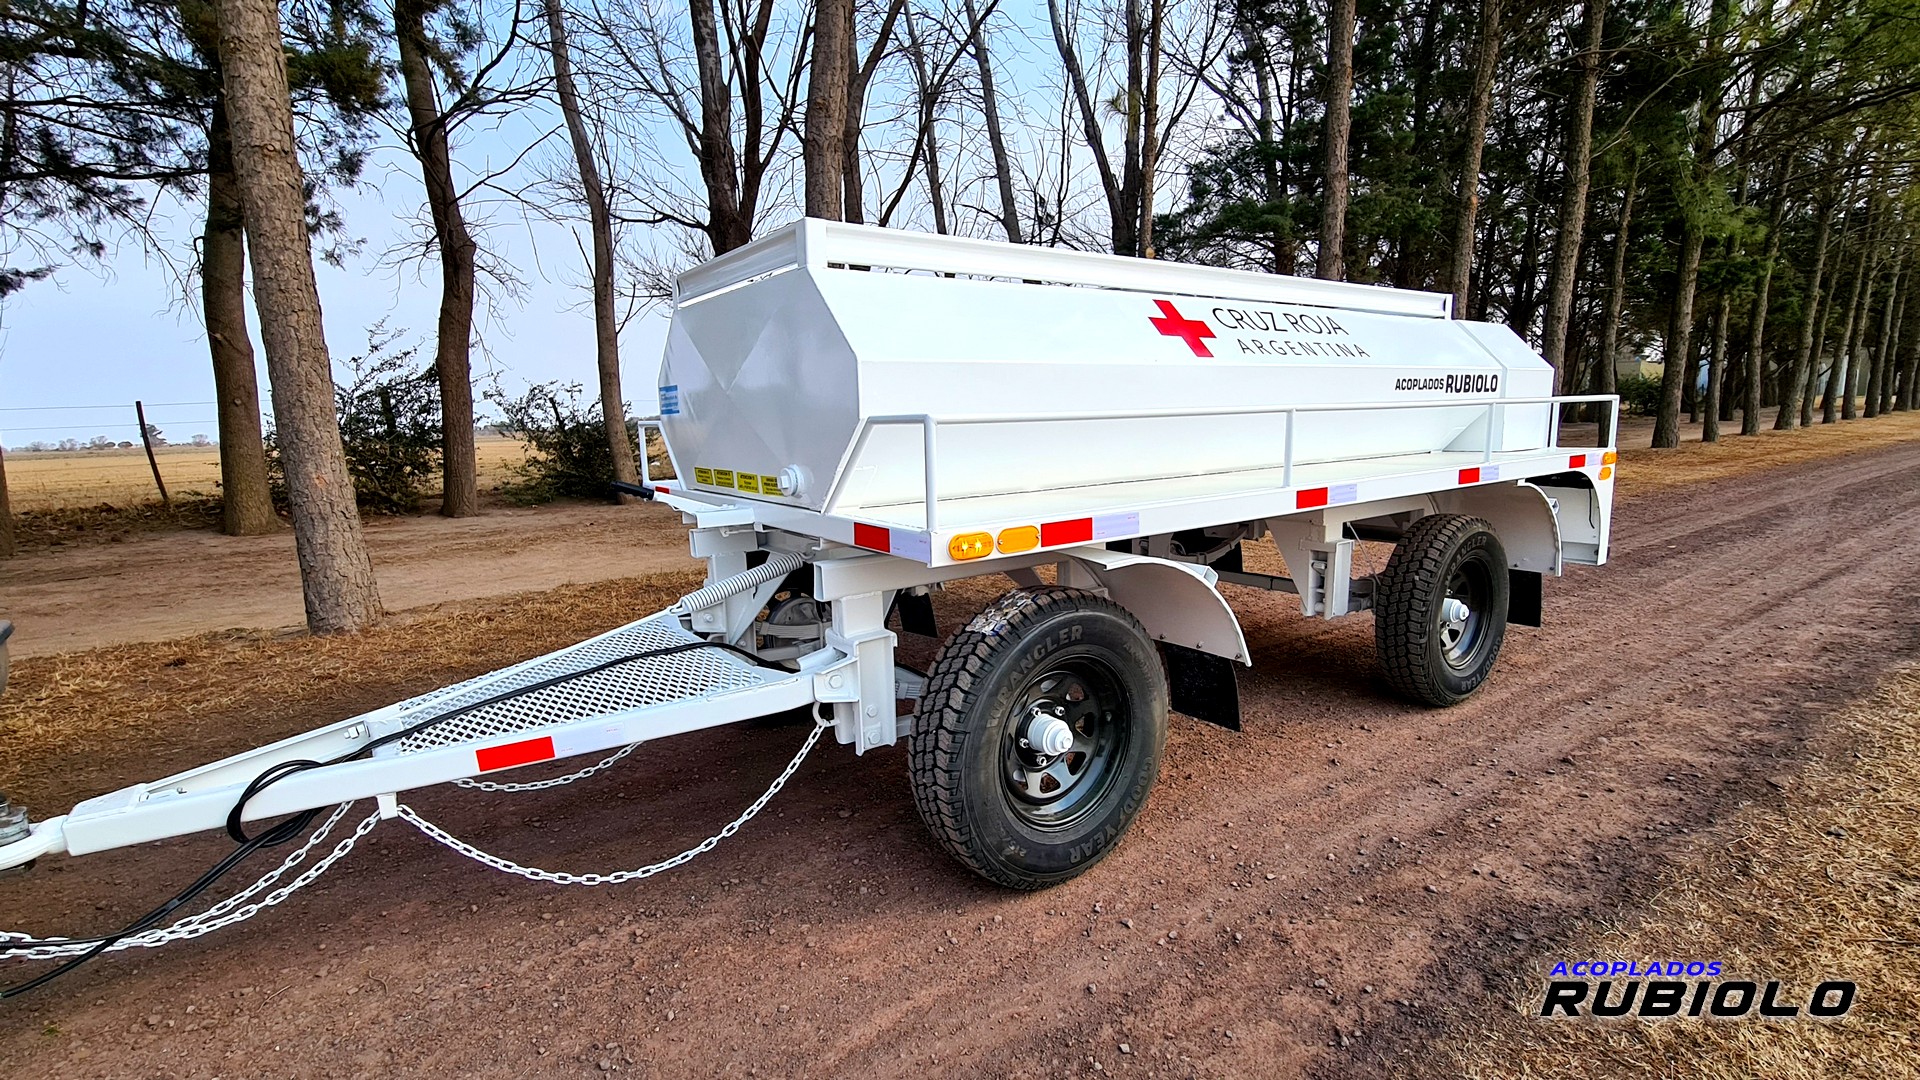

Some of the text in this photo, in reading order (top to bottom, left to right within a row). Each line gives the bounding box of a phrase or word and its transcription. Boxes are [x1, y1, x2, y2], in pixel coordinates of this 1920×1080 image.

[1212, 307, 1350, 336] CRUZ ROJA
[1236, 338, 1371, 358] ARGENTINA
[1394, 374, 1499, 393] ACOPLADOS RUBIOLO
[1444, 535, 1488, 586] WRANGLER
[985, 623, 1084, 729] WRANGLER
